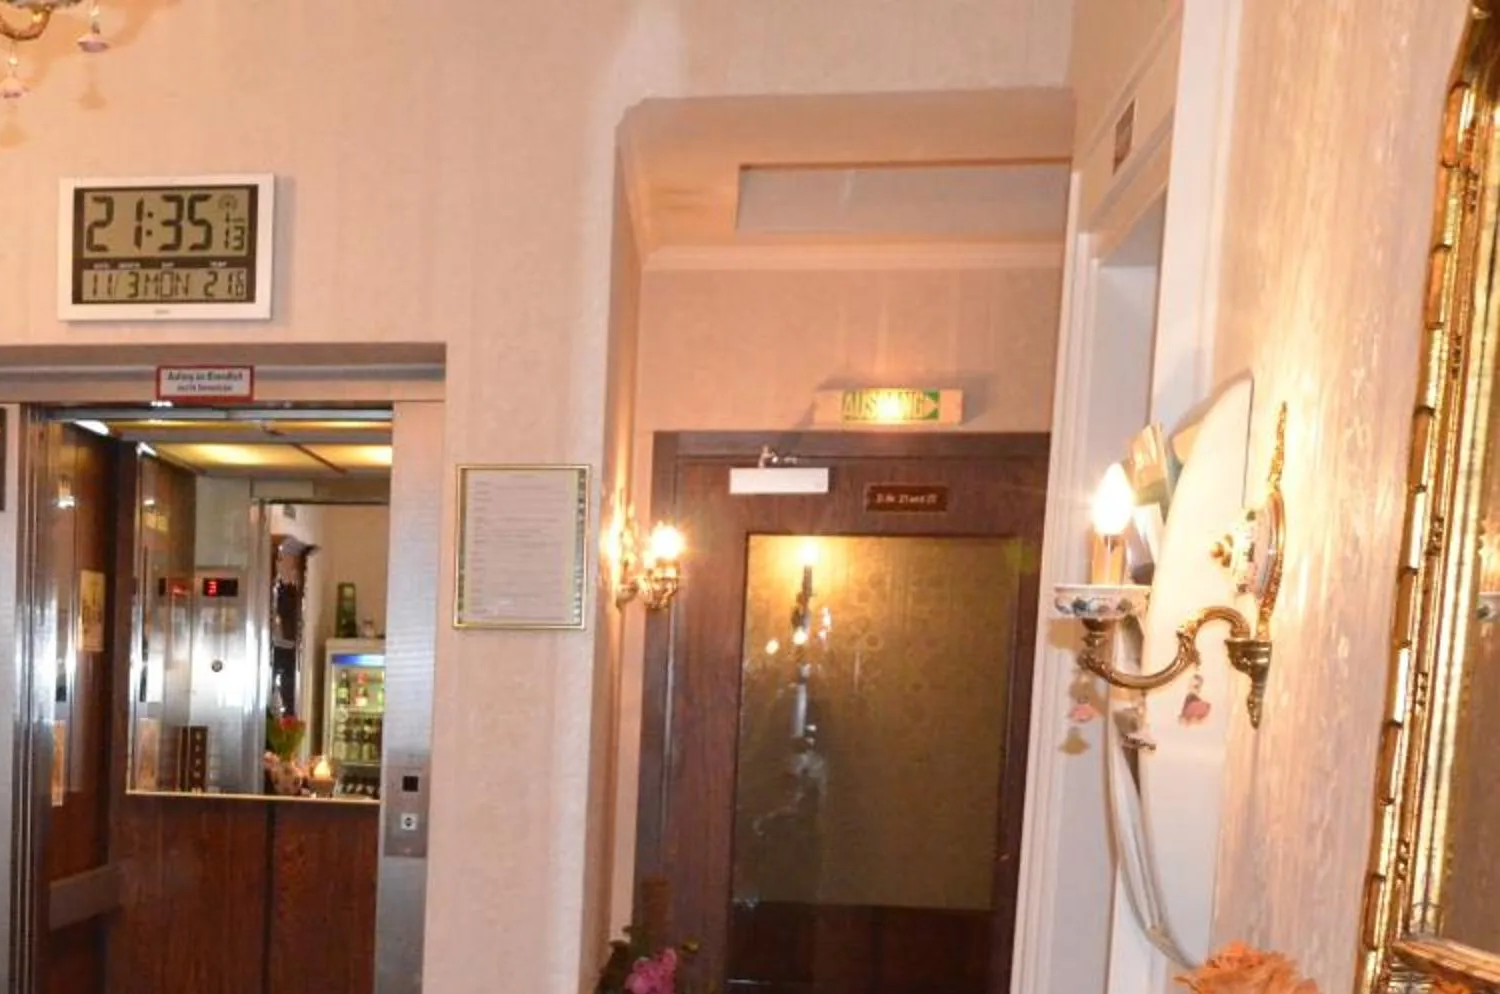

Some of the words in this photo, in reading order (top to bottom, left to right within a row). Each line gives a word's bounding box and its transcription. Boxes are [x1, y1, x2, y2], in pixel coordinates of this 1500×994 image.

[86, 193, 213, 252] 21:35
[144, 270, 191, 298] MON
[843, 391, 924, 418] AUSNG
